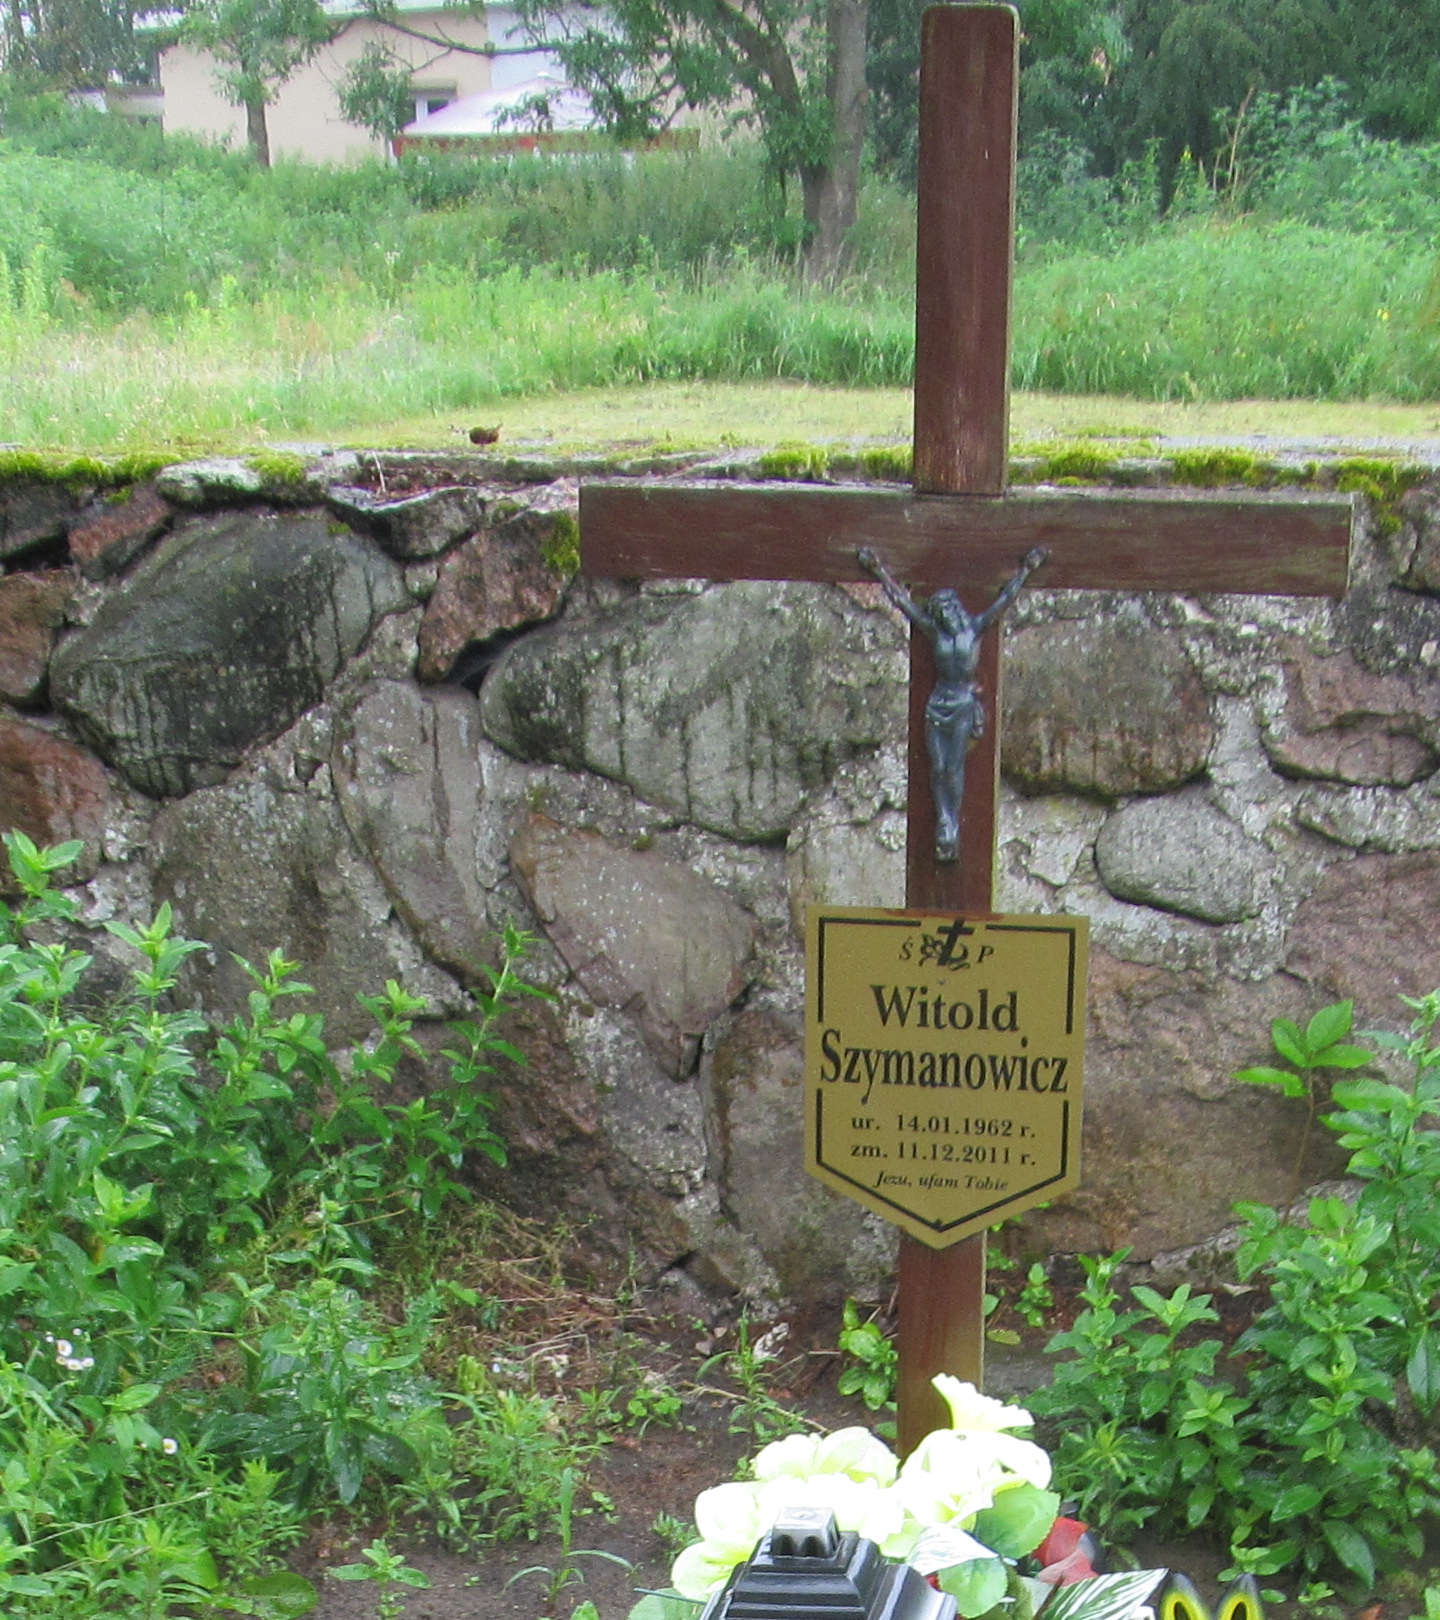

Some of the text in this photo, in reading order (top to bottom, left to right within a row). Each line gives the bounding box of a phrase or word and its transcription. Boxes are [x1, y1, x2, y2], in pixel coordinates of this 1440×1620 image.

[870, 984, 1019, 1032] Witold
[820, 1028, 1068, 1104] Szymanowicz
[851, 1114, 1036, 1138] ur. 14.01.1962 r.
[851, 1142, 1036, 1166] zm. 11.12.2011 r.
[964, 1174, 1008, 1191] Tobie
